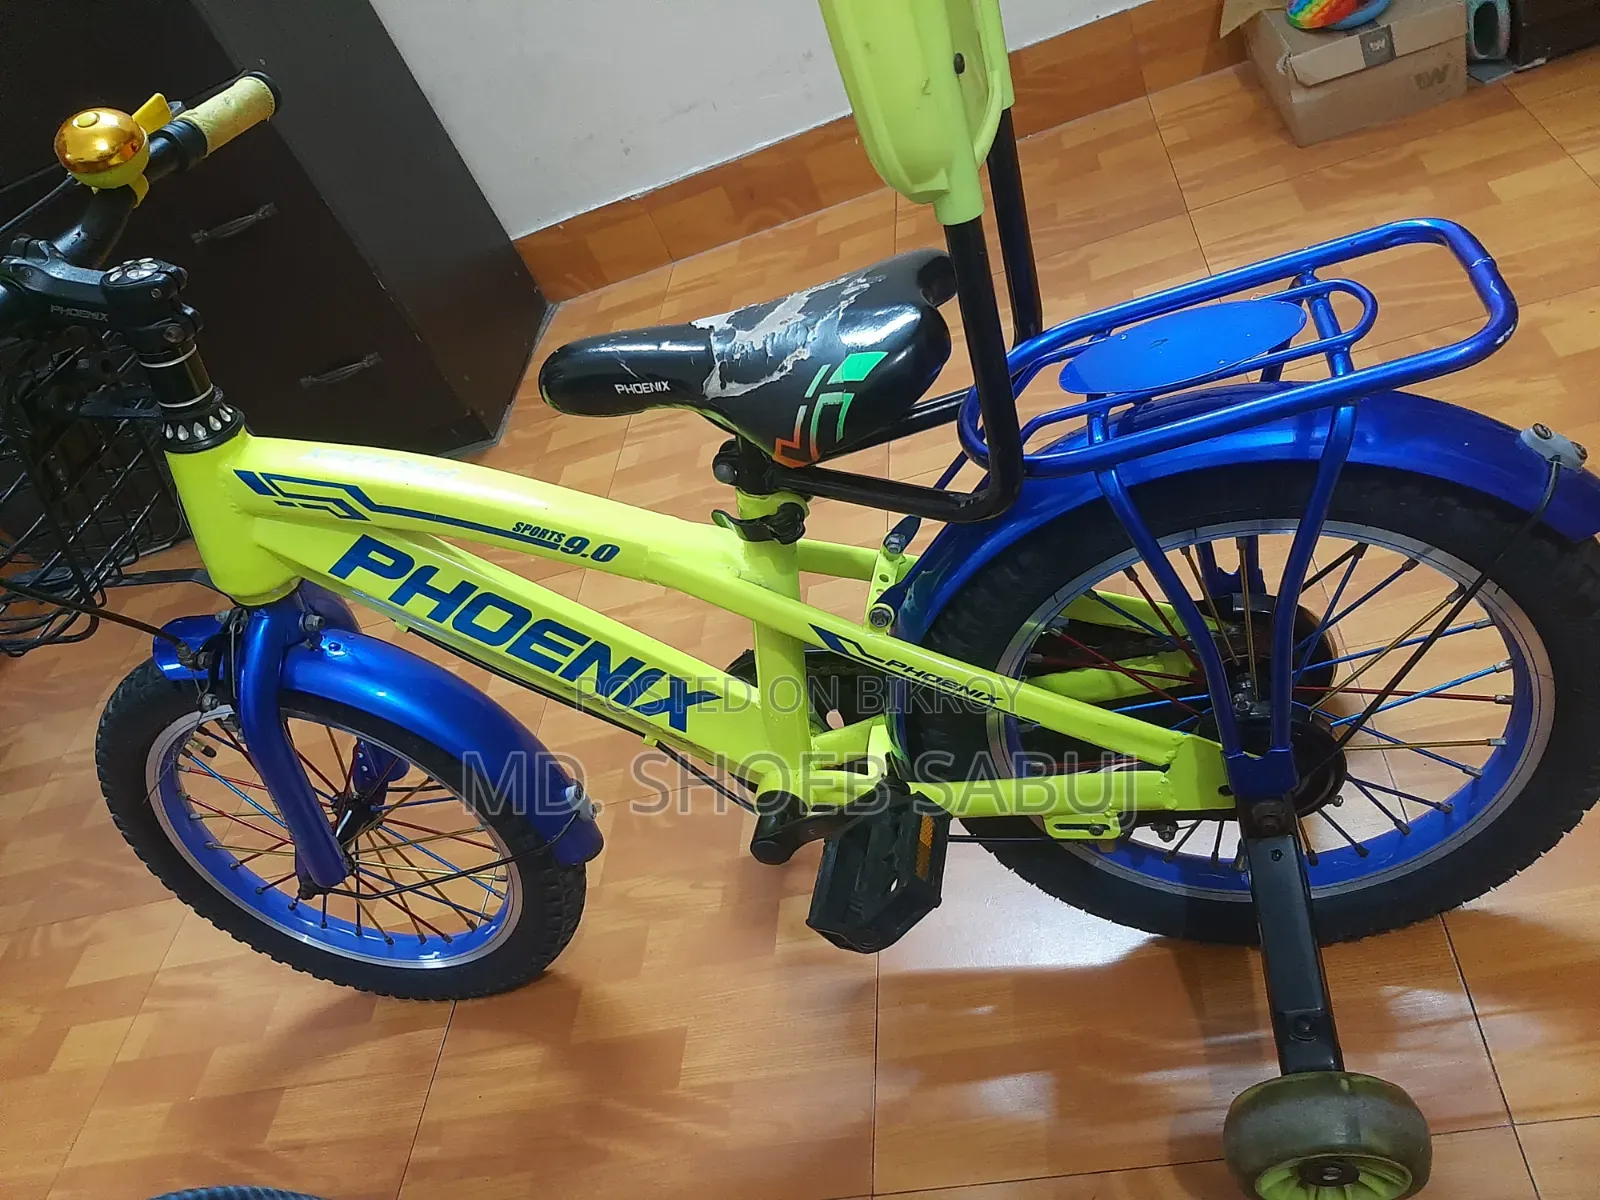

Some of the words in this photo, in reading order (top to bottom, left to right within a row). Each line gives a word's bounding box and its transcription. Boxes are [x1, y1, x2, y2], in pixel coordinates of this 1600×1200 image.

[50, 304, 109, 322] PHOENIX
[613, 380, 671, 395] PHOENIX
[511, 521, 567, 543] SPORTS
[559, 535, 621, 563] 9.0
[328, 533, 723, 732] PHOENIX
[885, 659, 1005, 705] PHOENIX
